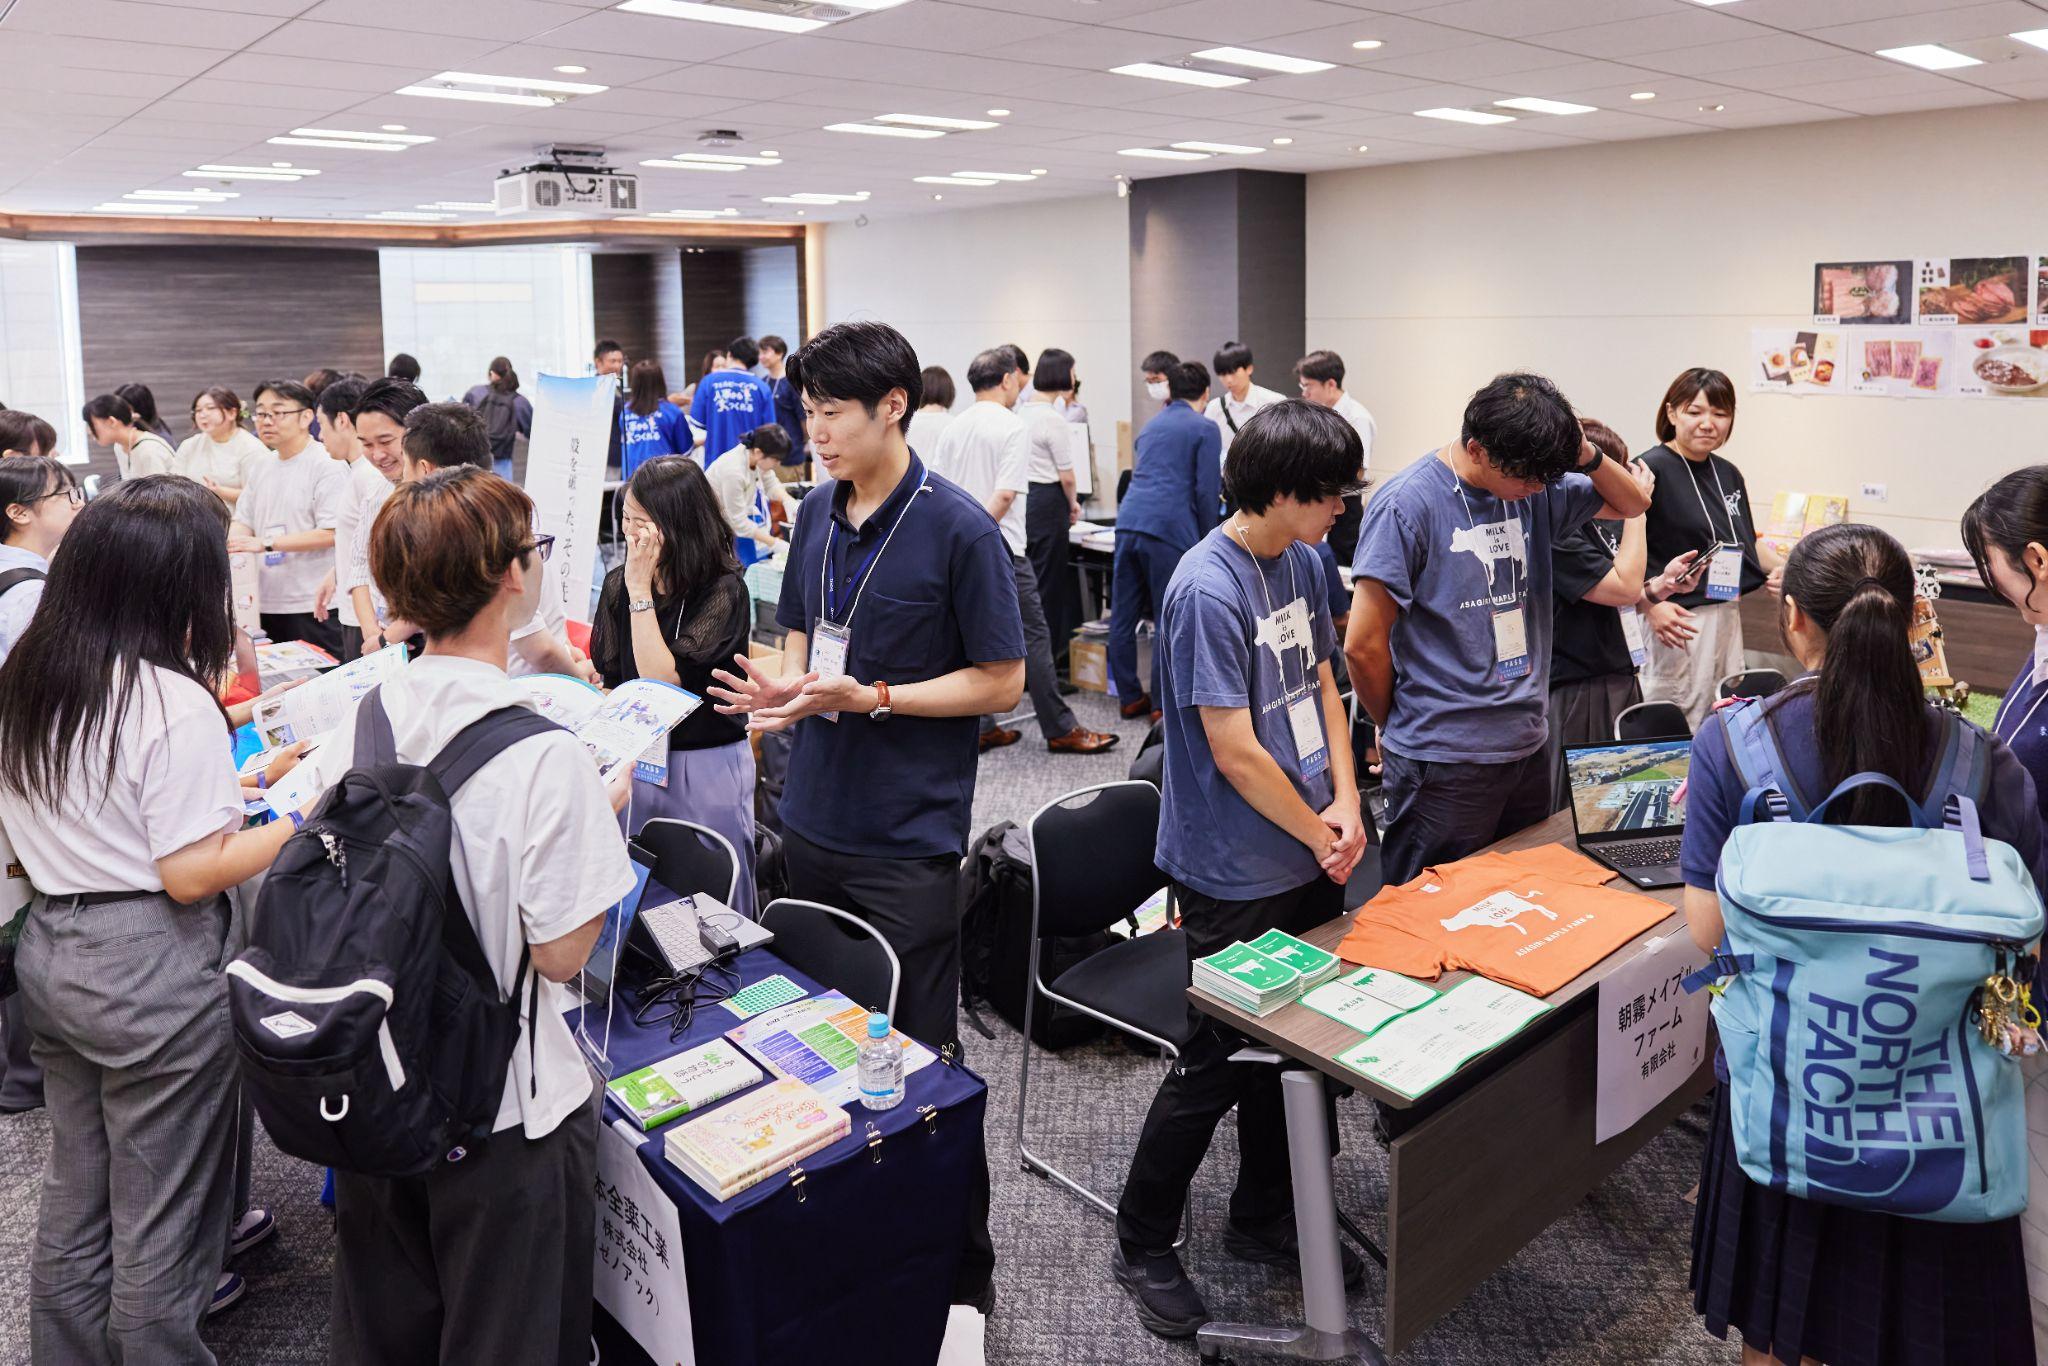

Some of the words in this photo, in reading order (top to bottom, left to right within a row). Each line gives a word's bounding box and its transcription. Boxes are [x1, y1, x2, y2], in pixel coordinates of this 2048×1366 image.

[1485, 526, 1506, 537] MILK
[1489, 542, 1510, 554] LOVE
[1275, 610, 1292, 626] MILK
[1505, 657, 1523, 669] PASS
[640, 762, 660, 774] PASS
[1306, 751, 1322, 767] PASS
[1488, 906, 1513, 920] LOVE
[1634, 1006, 1683, 1057] ファーム
[1856, 946, 1920, 1143] NORTH
[1640, 1041, 1677, 1080] 有限会社
[1802, 991, 1859, 1142] FACE
[1904, 1026, 1965, 1143] THE
[593, 1171, 670, 1270] 本全薬工業
[602, 1215, 649, 1276] 株式会社
